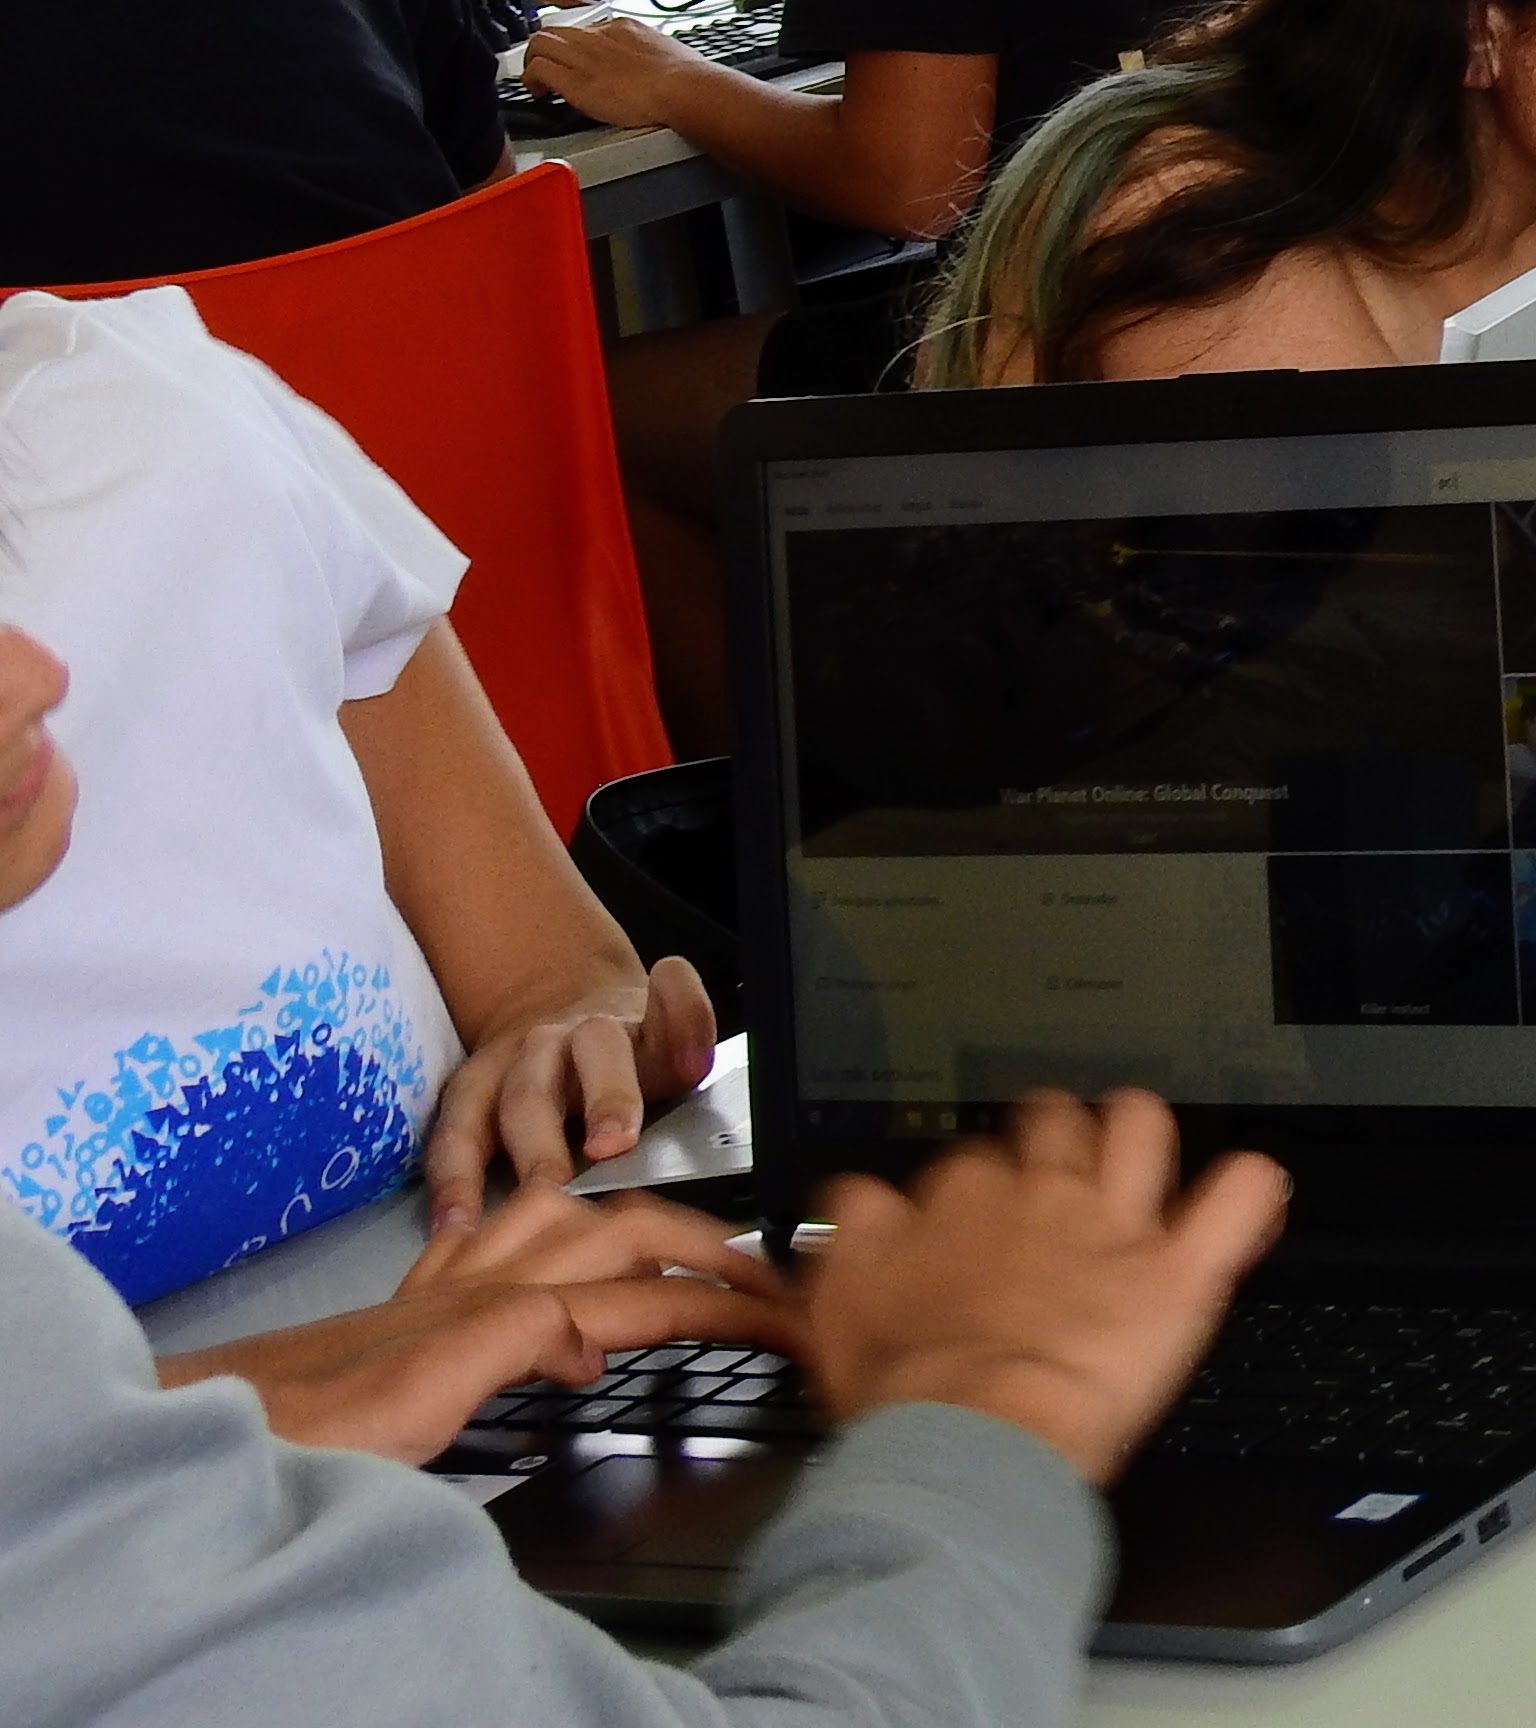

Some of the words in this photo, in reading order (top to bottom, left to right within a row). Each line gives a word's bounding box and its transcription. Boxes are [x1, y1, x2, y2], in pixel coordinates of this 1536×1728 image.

[1036, 786, 1088, 804] Planet
[1153, 783, 1206, 803] Global
[1210, 783, 1289, 805] Conquest
